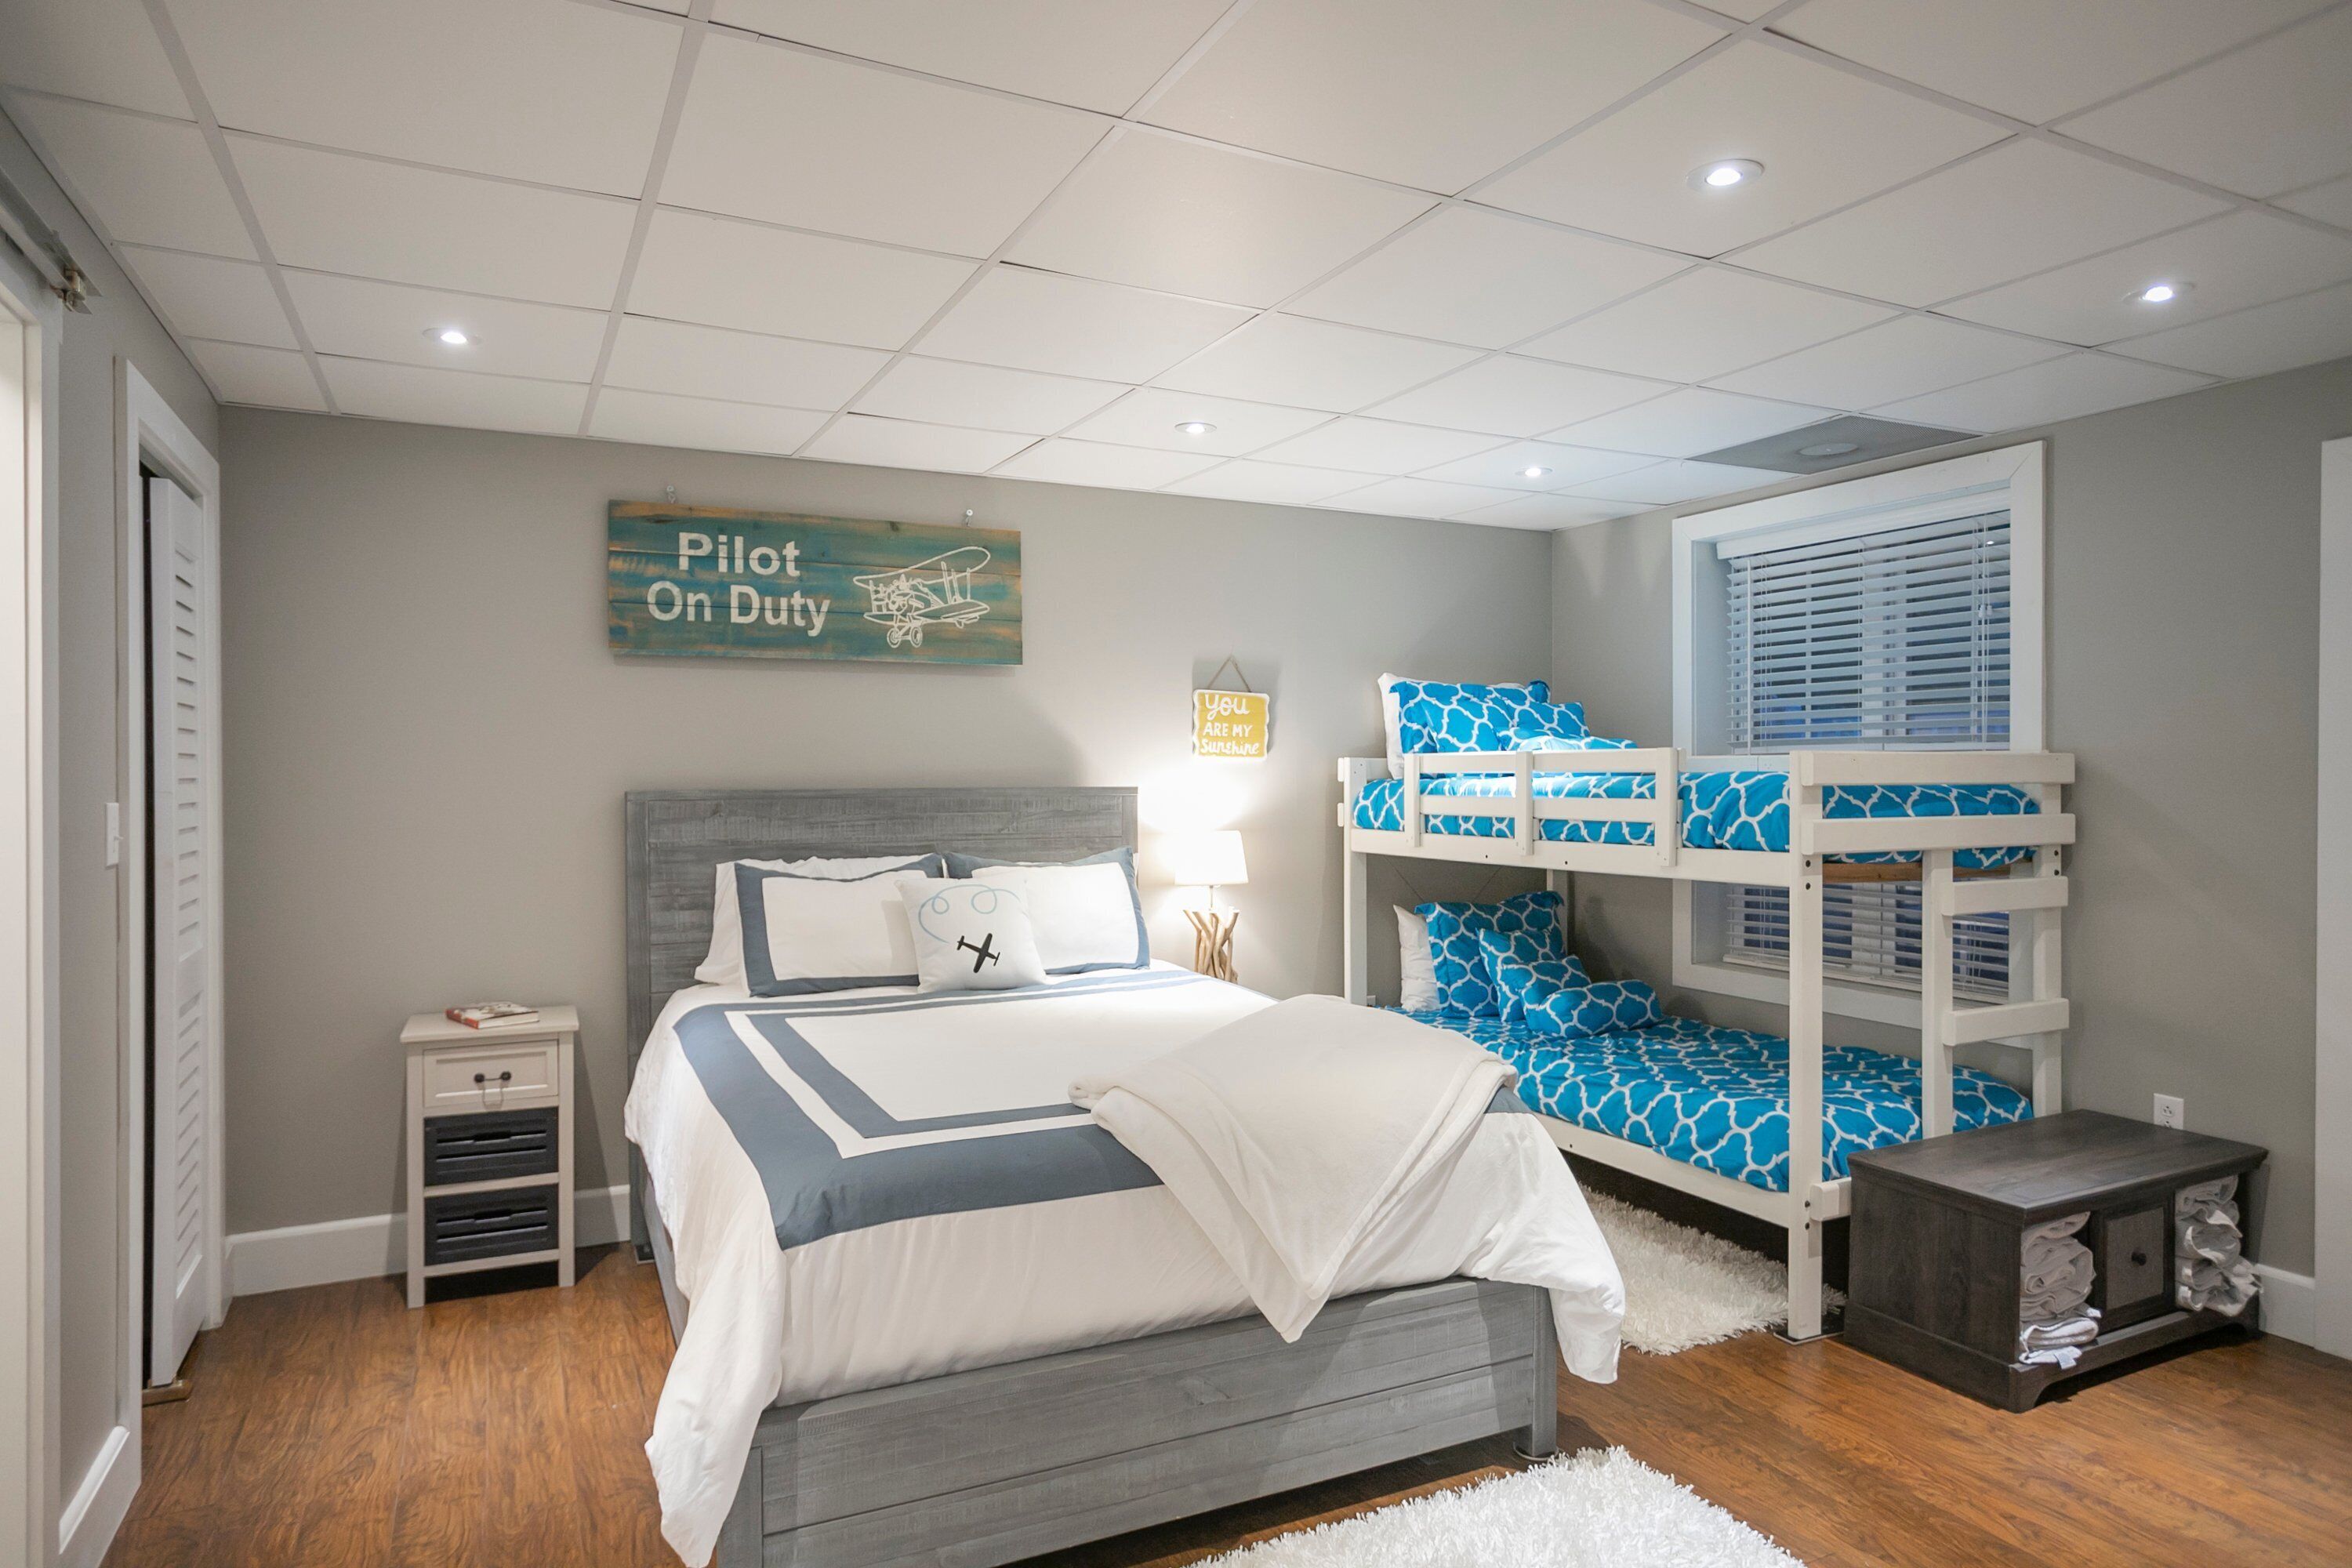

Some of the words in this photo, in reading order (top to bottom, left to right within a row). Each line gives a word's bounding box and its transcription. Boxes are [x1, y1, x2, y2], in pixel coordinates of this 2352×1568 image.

[677, 531, 800, 577] Pilot
[647, 580, 712, 622] On
[729, 584, 832, 637] Duty
[1203, 723, 1229, 736] ARE
[1232, 724, 1253, 737] MY
[1200, 739, 1259, 755] Sunshine
